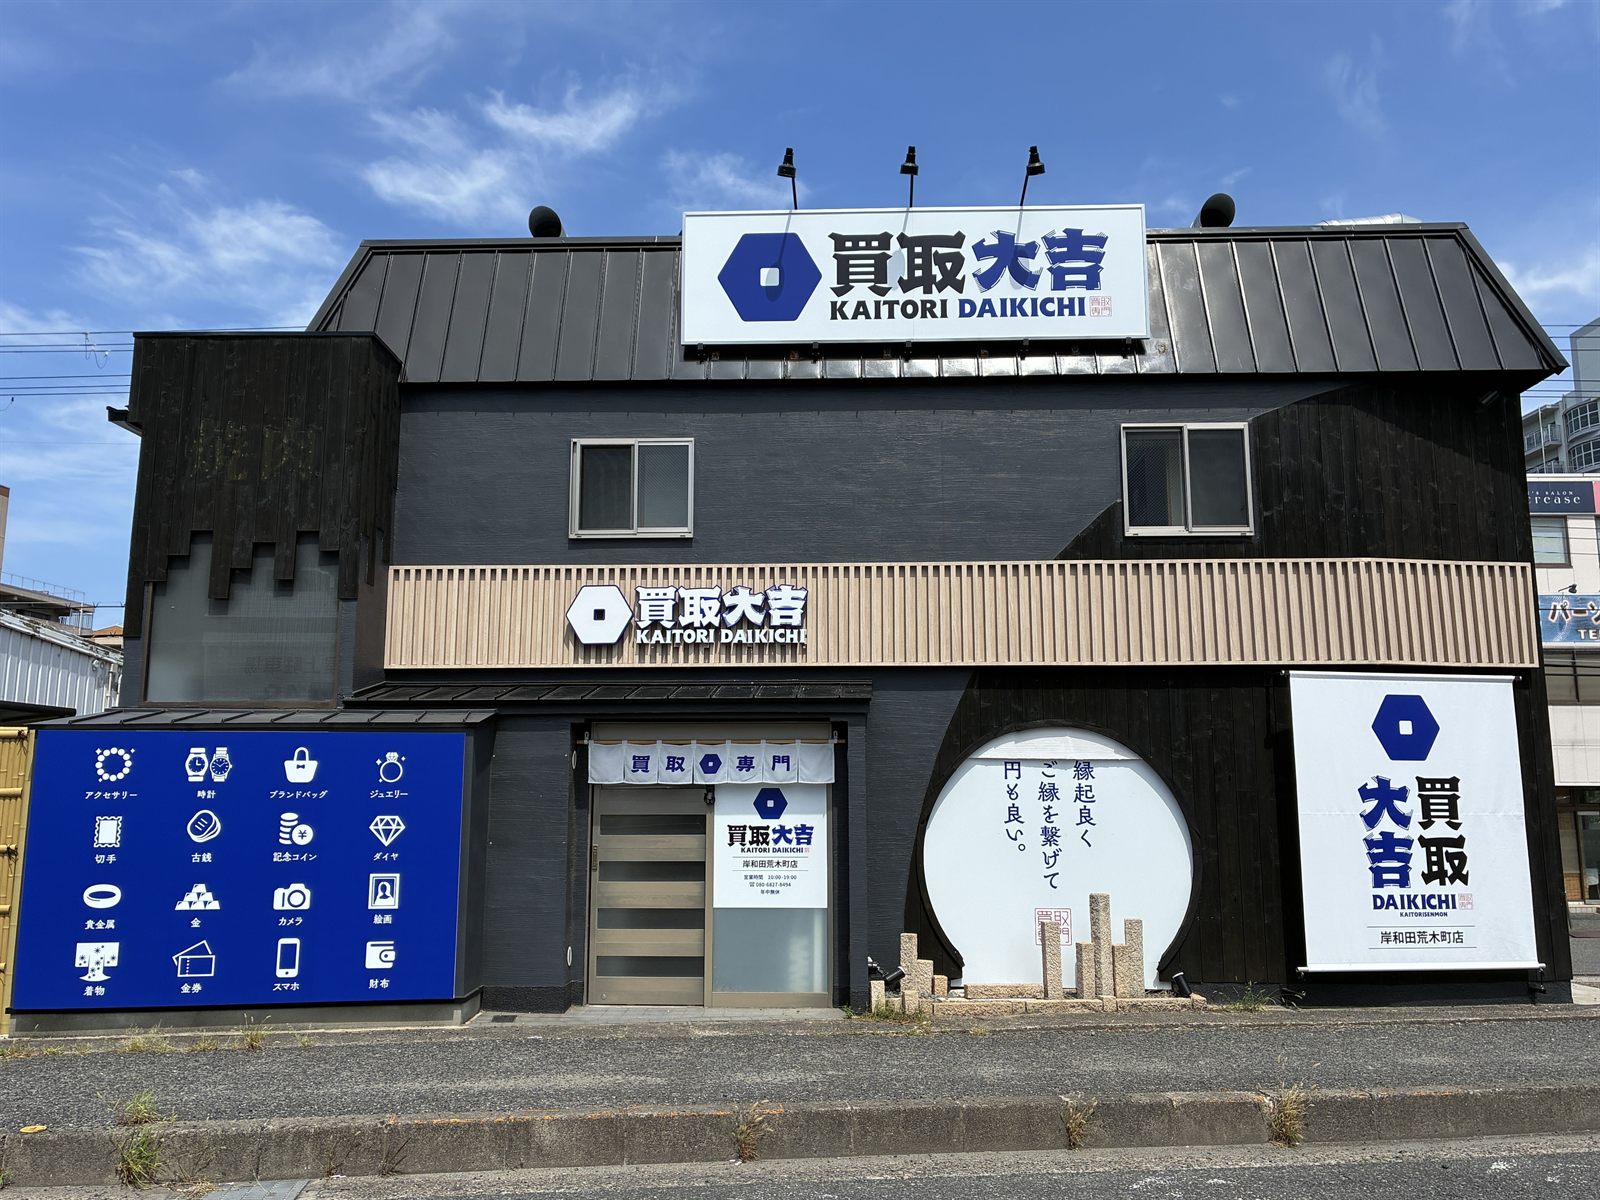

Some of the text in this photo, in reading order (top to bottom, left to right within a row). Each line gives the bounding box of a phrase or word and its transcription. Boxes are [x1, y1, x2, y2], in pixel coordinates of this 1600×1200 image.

[829, 228, 1108, 297] 買取大吉
[830, 297, 1086, 320] KAITORI DAIKICHI
[634, 584, 808, 628] 買取大吉
[636, 628, 807, 644] KAITORI DAIKICHI
[1577, 629, 1600, 640] TE
[631, 755, 790, 773] 買取 専門
[85, 791, 137, 799] アクセサリー
[197, 790, 216, 798] 時計
[270, 790, 328, 798] ブランドバッグ
[370, 790, 408, 798] ジュエリー
[1004, 761, 1026, 851] 円も良い。
[1073, 760, 1096, 847] 縁起良く
[1037, 760, 1062, 889] ご縁を繋げて
[727, 824, 814, 846] 買取大吉
[1358, 775, 1415, 888] 大吉
[1415, 776, 1469, 886] 買取
[95, 854, 116, 864] 切手
[192, 853, 212, 862] 古銭
[273, 852, 317, 861] 記念コイン
[374, 852, 398, 861] ダイヤ
[742, 859, 798, 869] 岸和田荒木町店
[1372, 894, 1457, 910] DAIKICHI
[191, 918, 201, 927] 金
[279, 917, 302, 926] カメラ
[373, 914, 392, 924] 絵画
[85, 920, 115, 929] 貴金属
[1381, 930, 1463, 944] 岸和田荒木町店
[181, 983, 201, 993] 金券
[273, 982, 299, 991] スマホ
[369, 979, 389, 988] 財布
[83, 986, 105, 996] 着物
